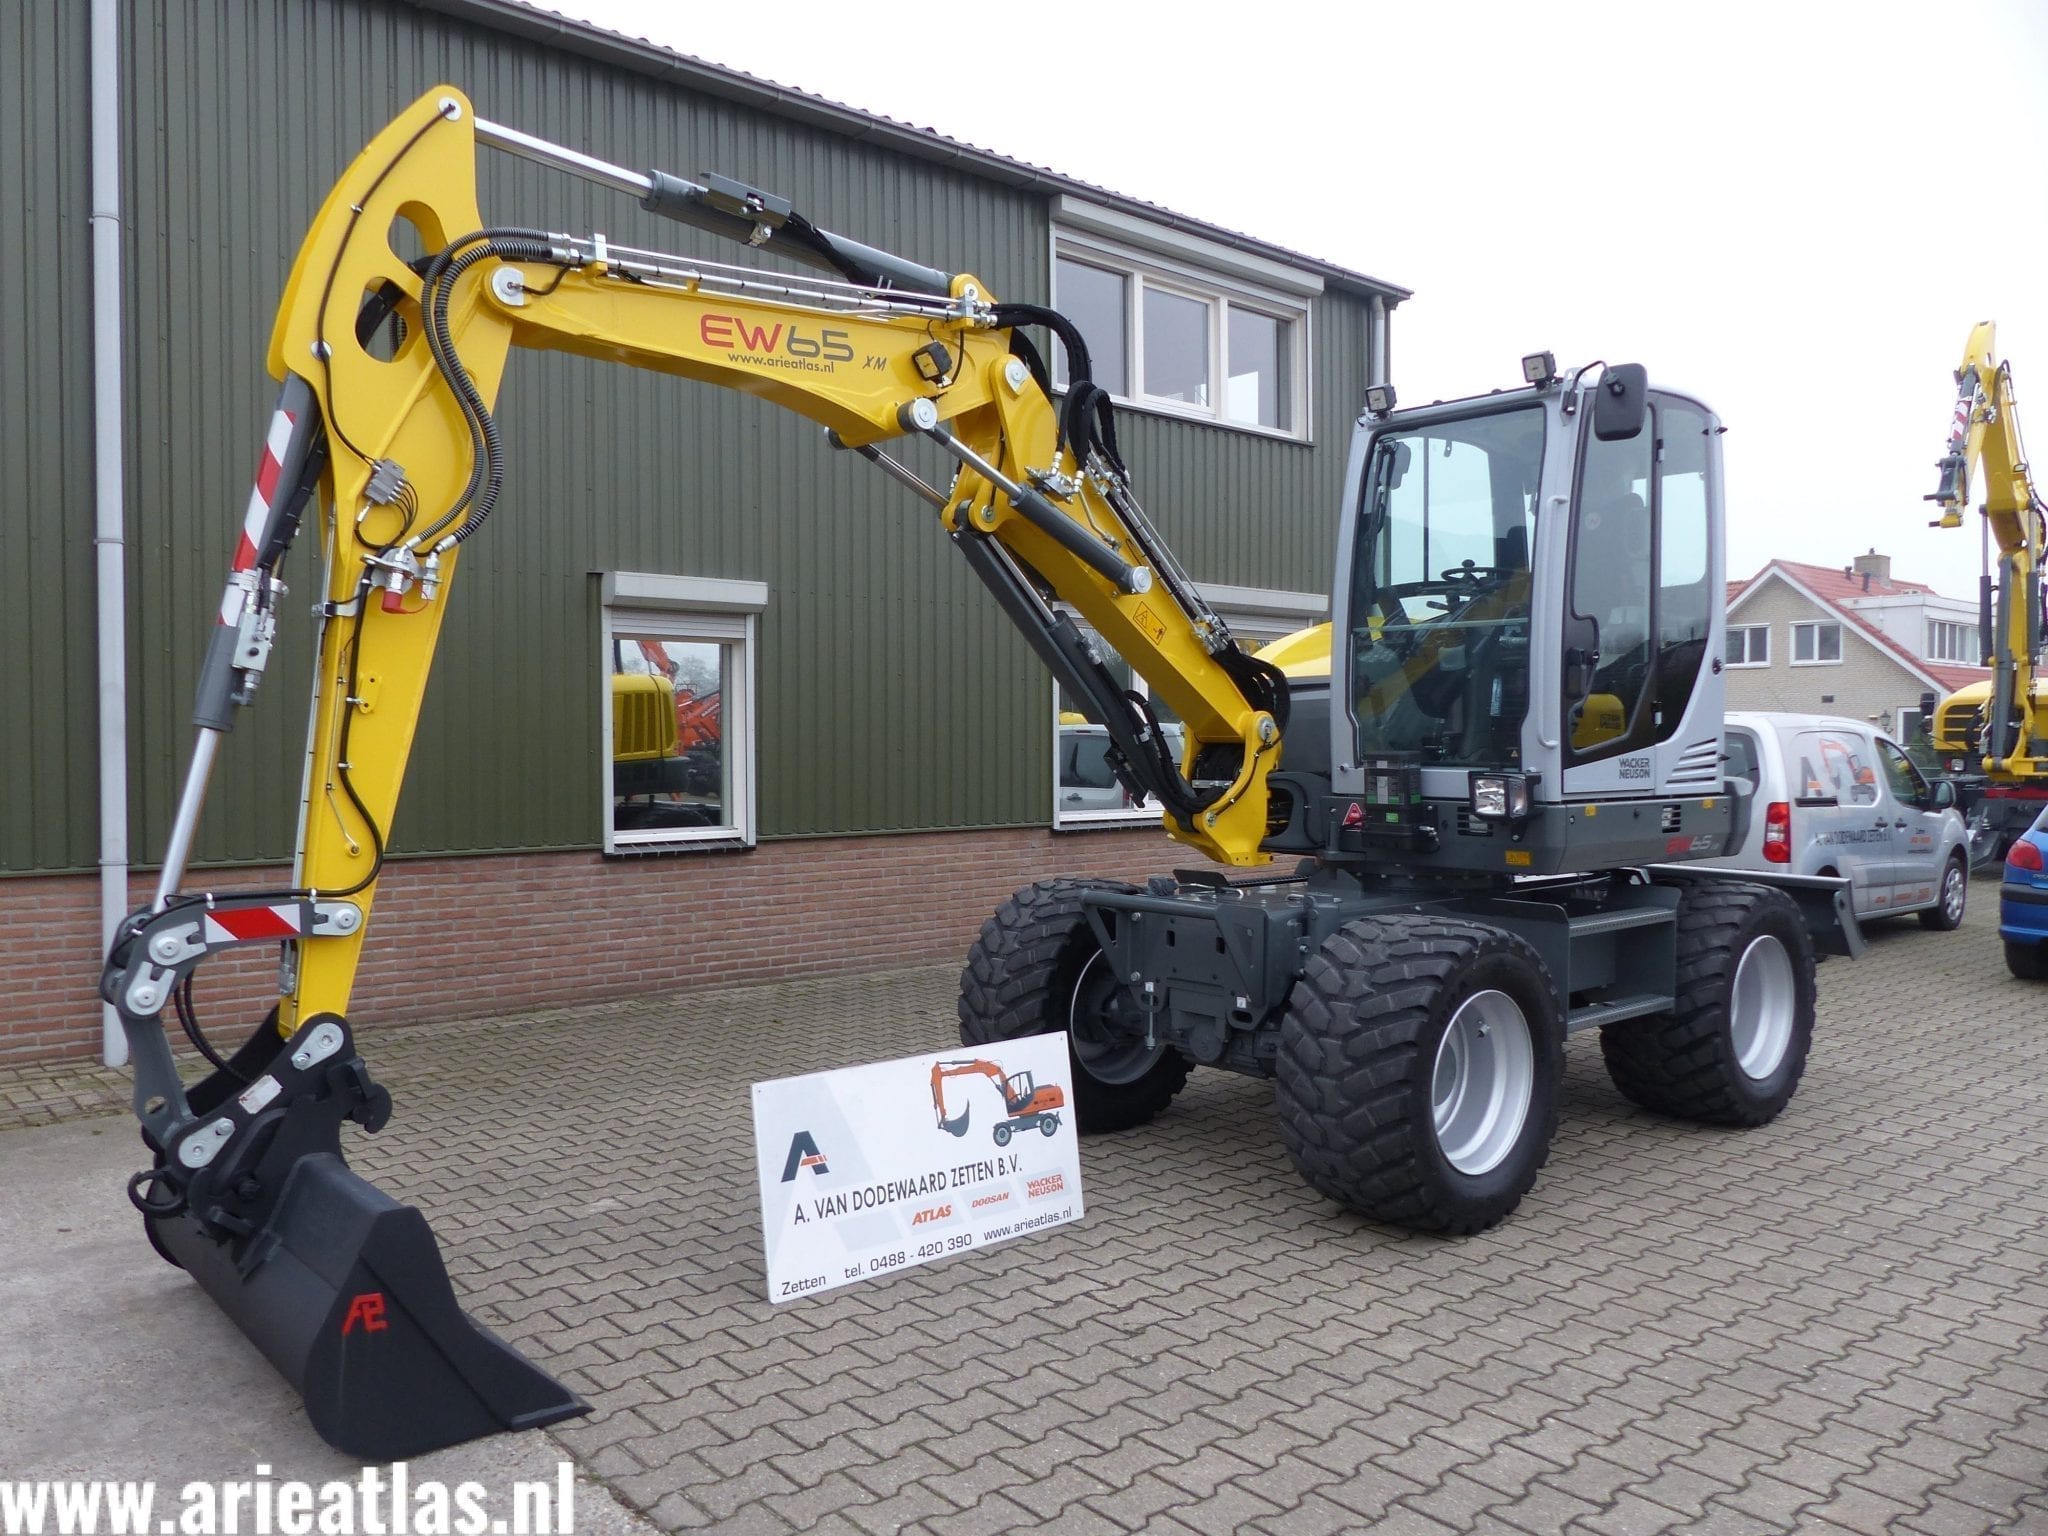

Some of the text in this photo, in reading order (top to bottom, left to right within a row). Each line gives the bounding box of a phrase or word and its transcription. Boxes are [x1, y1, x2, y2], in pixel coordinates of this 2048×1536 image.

[700, 314, 854, 362] EW65
[728, 351, 835, 374] www.arieatlas.nl
[862, 355, 887, 372] XM
[1619, 757, 1650, 768] WACKER
[1619, 769, 1650, 779] NEUSON
[794, 1153, 1022, 1225] A. VAN DODEWAARD ZETTEN B.V.
[1026, 1174, 1062, 1189] WACKER
[1028, 1182, 1064, 1199] NEUSON
[971, 1192, 1010, 1208] DOOSAN
[912, 1205, 952, 1225] ATLAS
[781, 1275, 826, 1296] Zetten
[844, 1263, 865, 1279] tel.
[870, 1251, 905, 1272] 0488
[918, 1241, 943, 1257] 420
[947, 1233, 972, 1251] 390
[984, 1206, 1072, 1240] www.arieatlas.nl
